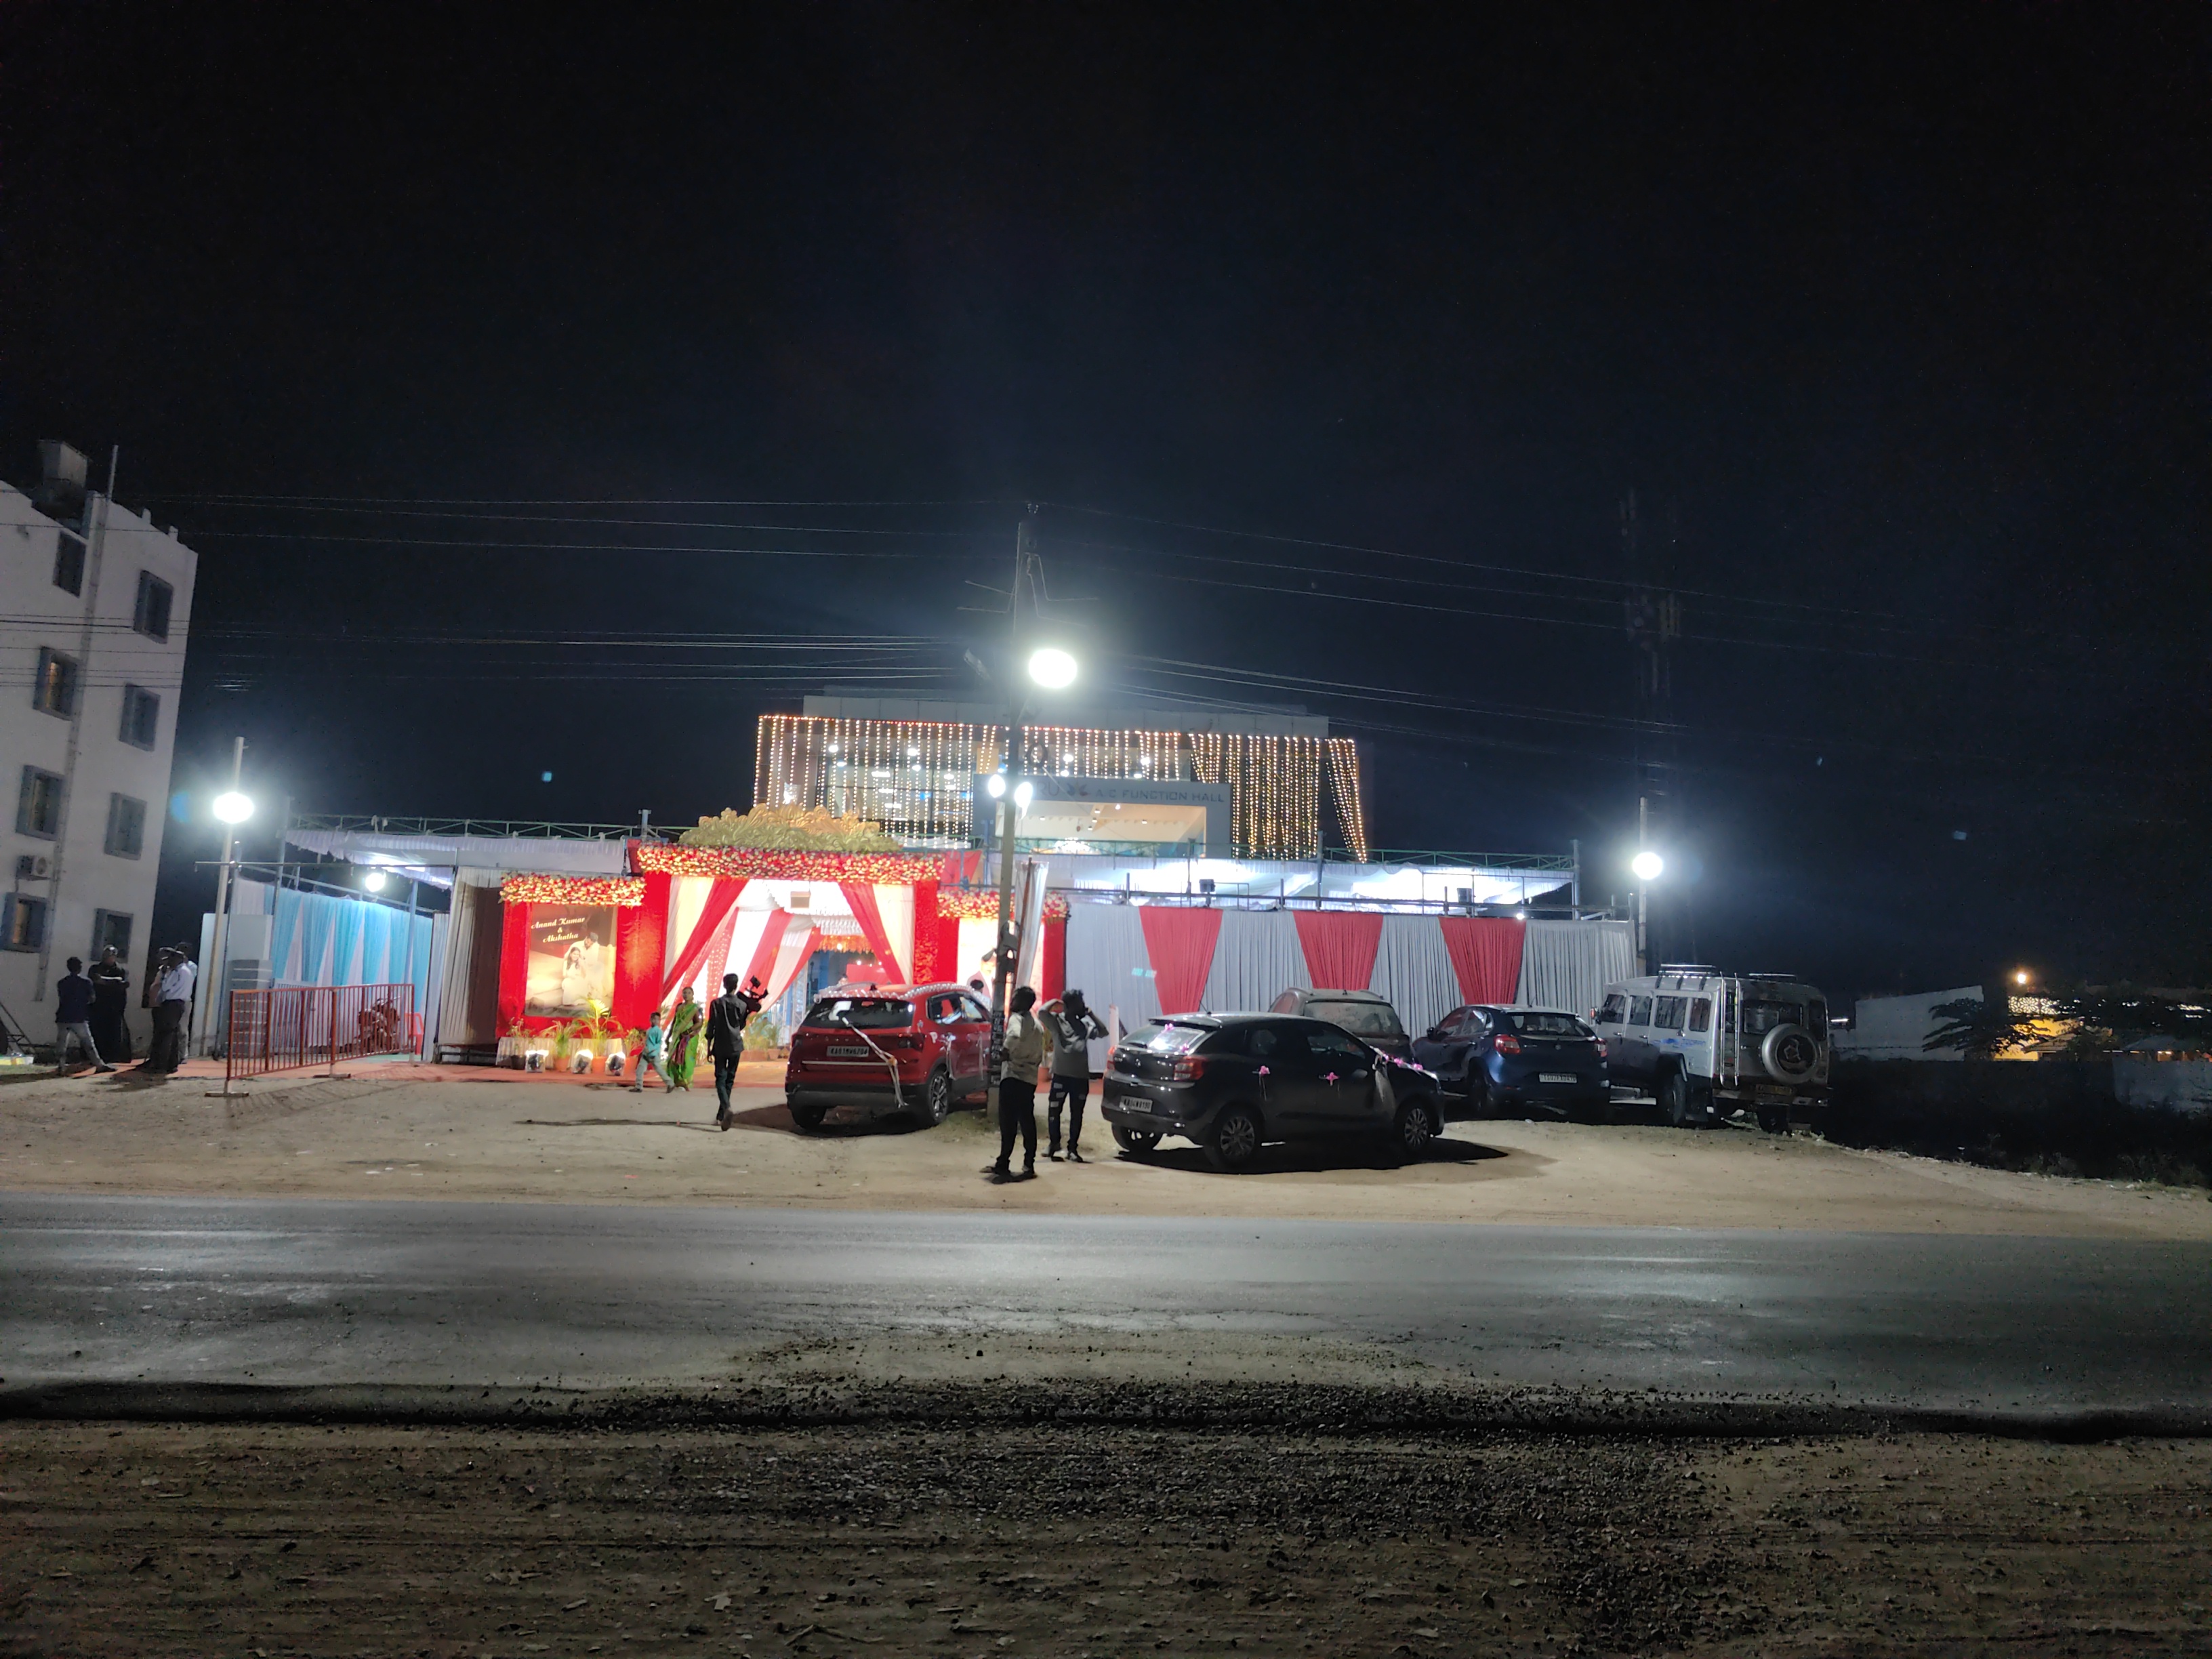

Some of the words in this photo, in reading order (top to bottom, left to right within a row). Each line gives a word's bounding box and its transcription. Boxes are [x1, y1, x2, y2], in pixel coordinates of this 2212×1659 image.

[1122, 789, 1187, 800] FUNCTION
[1192, 792, 1225, 802] HALL
[531, 918, 557, 930] Anand
[558, 917, 586, 926] Kumar
[542, 932, 579, 943] Akshatha
